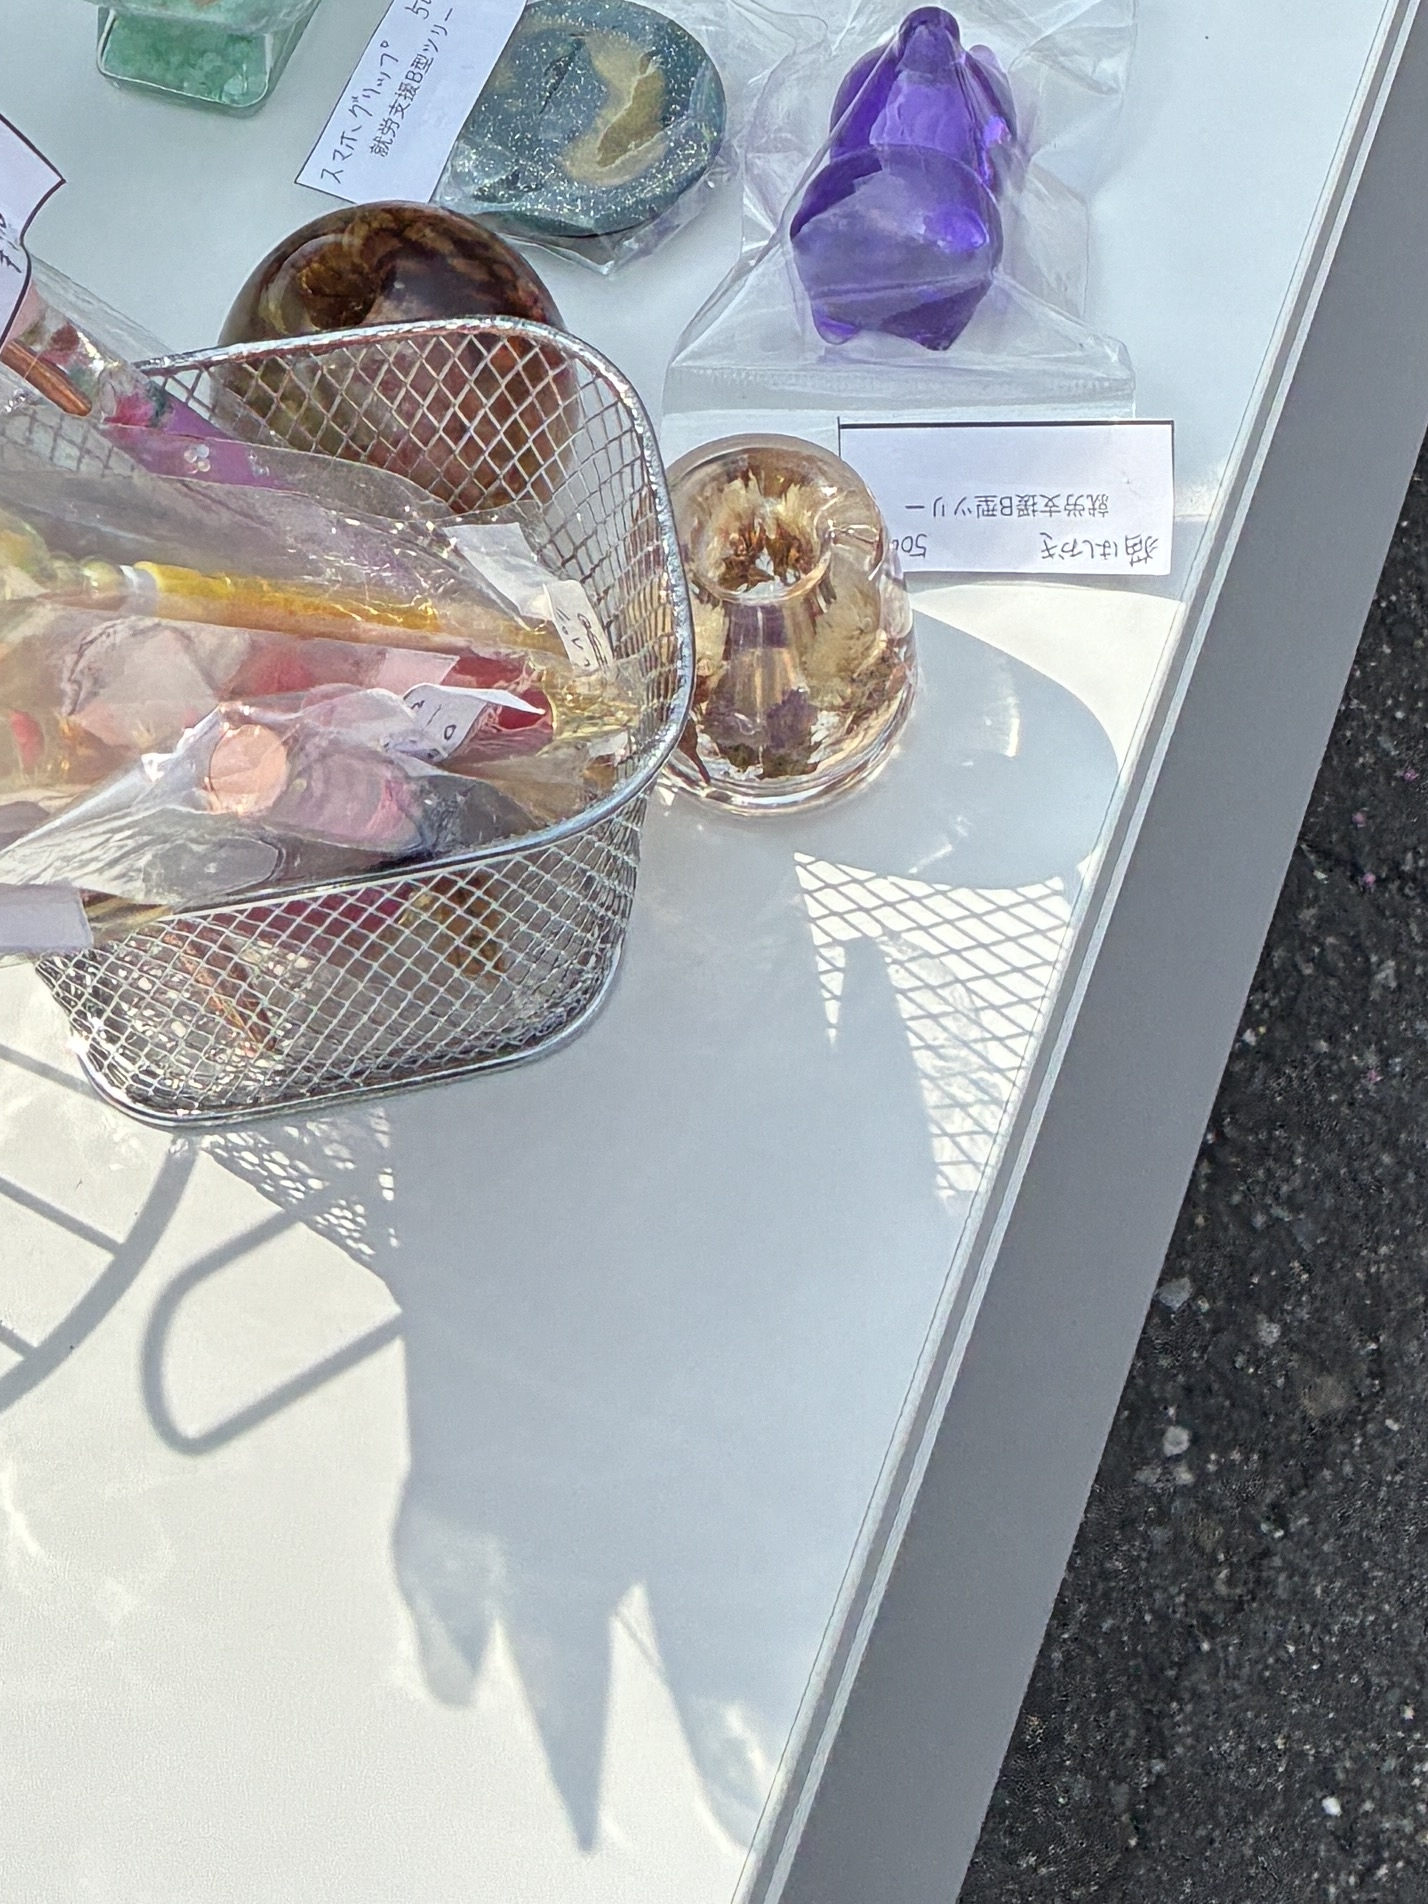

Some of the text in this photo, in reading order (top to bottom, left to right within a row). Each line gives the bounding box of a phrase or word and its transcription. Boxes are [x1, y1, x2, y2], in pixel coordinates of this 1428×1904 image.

[368, 5, 457, 158] 就労支援B型ツリー
[904, 493, 1111, 519] 就労支援B型ツリー
